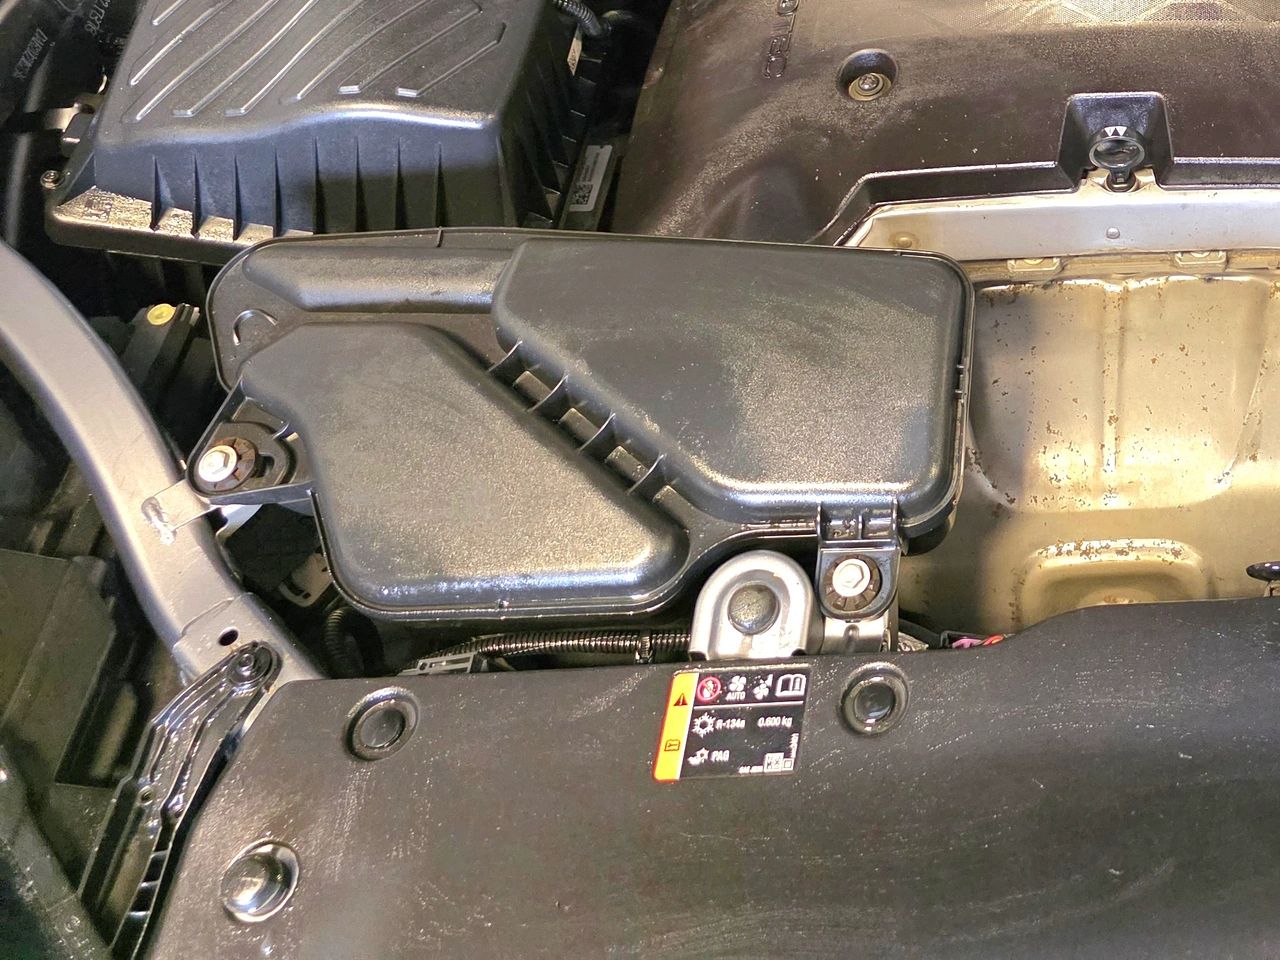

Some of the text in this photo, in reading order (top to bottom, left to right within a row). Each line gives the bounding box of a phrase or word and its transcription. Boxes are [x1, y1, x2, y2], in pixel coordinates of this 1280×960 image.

[725, 691, 746, 702] AUTO
[757, 716, 781, 729] 0.600
[710, 749, 730, 763] PAG
